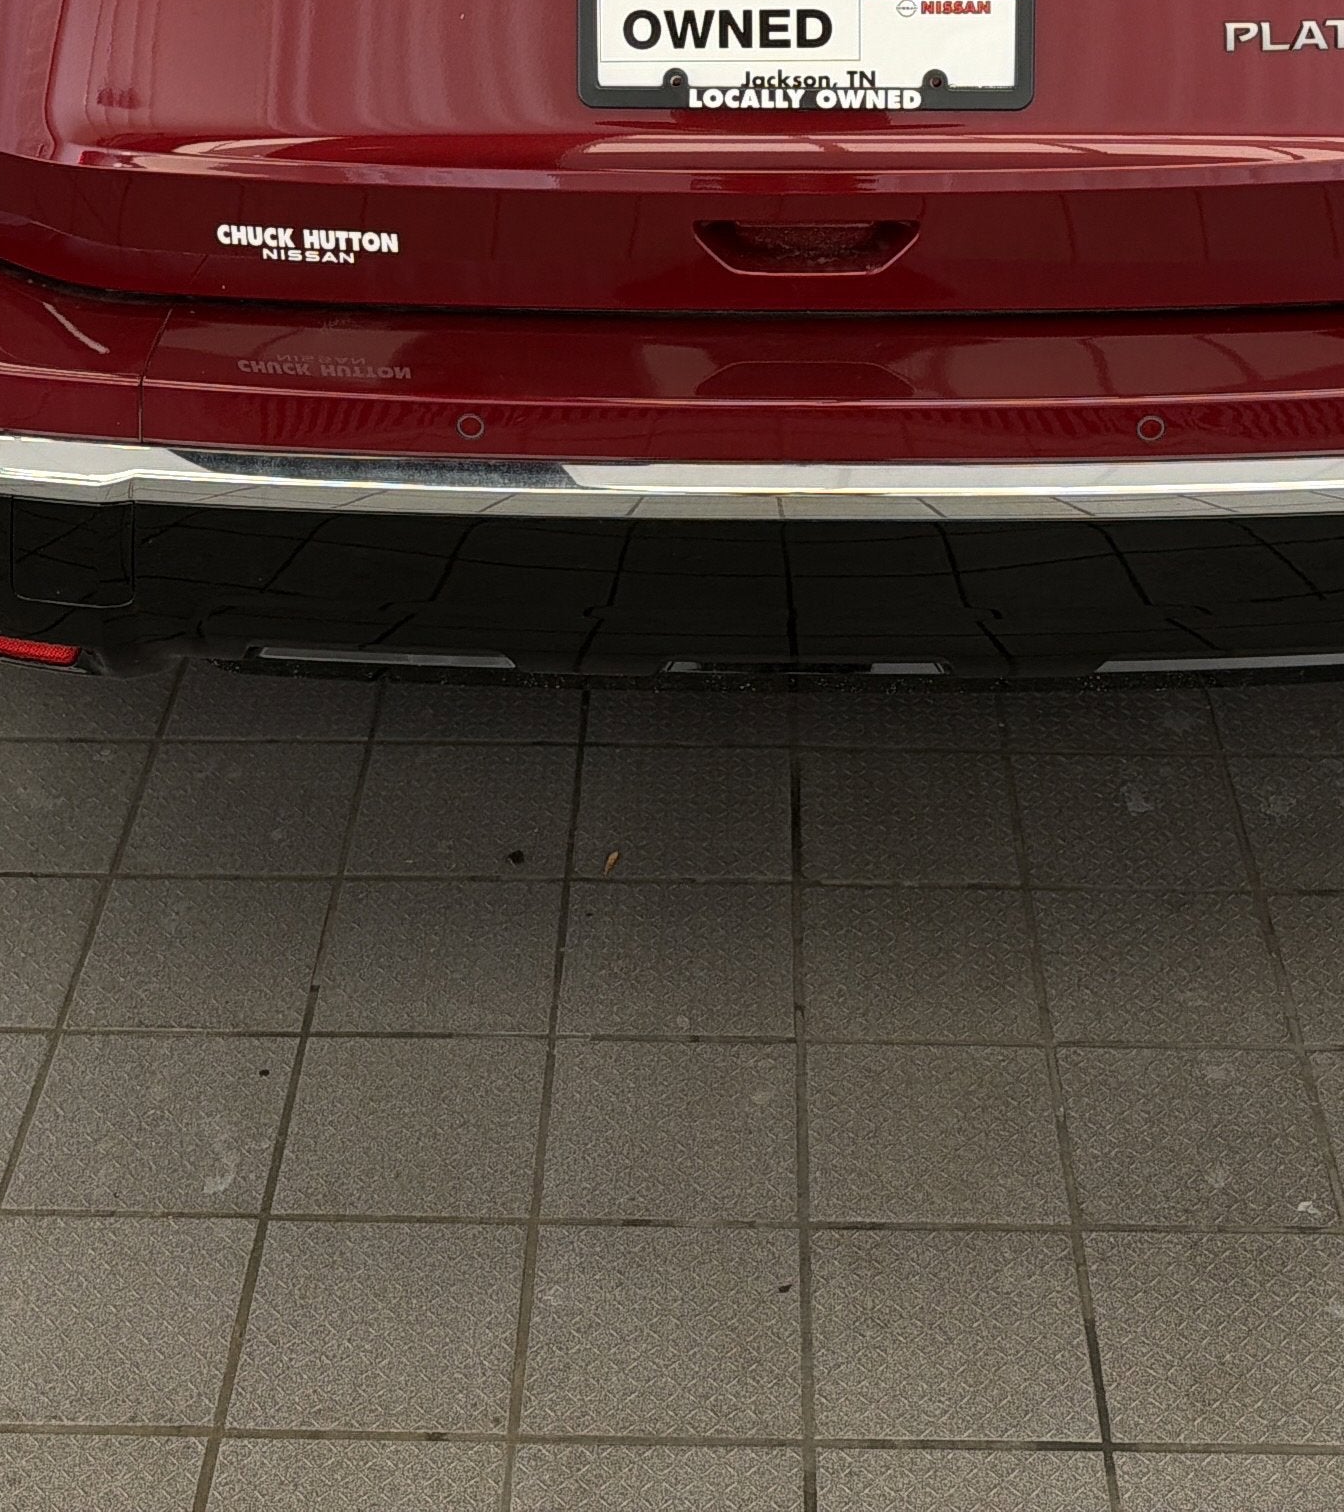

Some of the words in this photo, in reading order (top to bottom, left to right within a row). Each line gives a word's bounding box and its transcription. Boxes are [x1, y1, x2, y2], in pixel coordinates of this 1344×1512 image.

[920, 0, 992, 15] NISSAN
[622, 8, 834, 50] OWNED
[846, 70, 877, 88] TN
[688, 88, 806, 109] LOCALLY
[815, 88, 923, 110] OWNED
[216, 223, 295, 249] CHUCK
[303, 228, 400, 253] HUTTON
[262, 248, 355, 264] NISSAN
